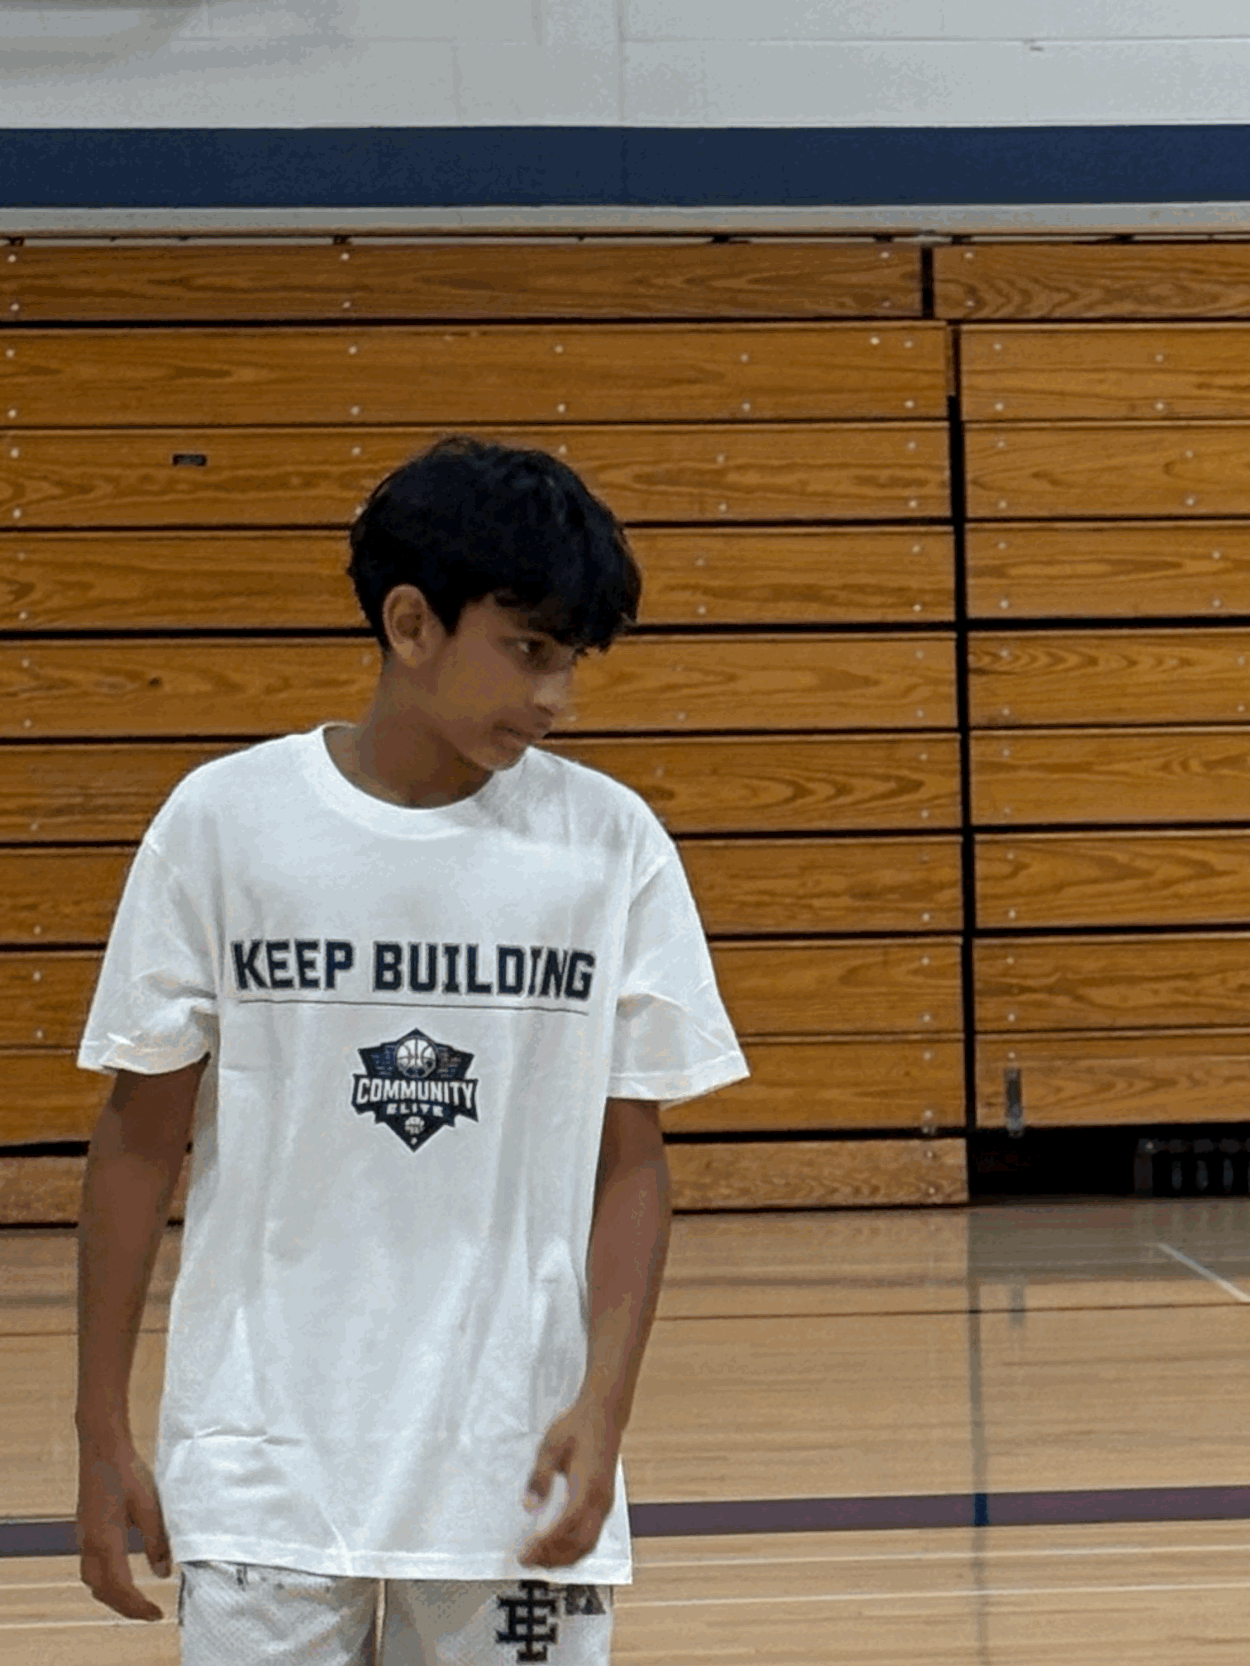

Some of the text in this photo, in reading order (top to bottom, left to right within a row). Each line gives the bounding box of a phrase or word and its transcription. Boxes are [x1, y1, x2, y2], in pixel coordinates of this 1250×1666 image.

[231, 938, 596, 1001] KEEP BUILDING
[355, 1077, 475, 1110] COMMUNITY
[385, 1102, 445, 1118] ELITE
